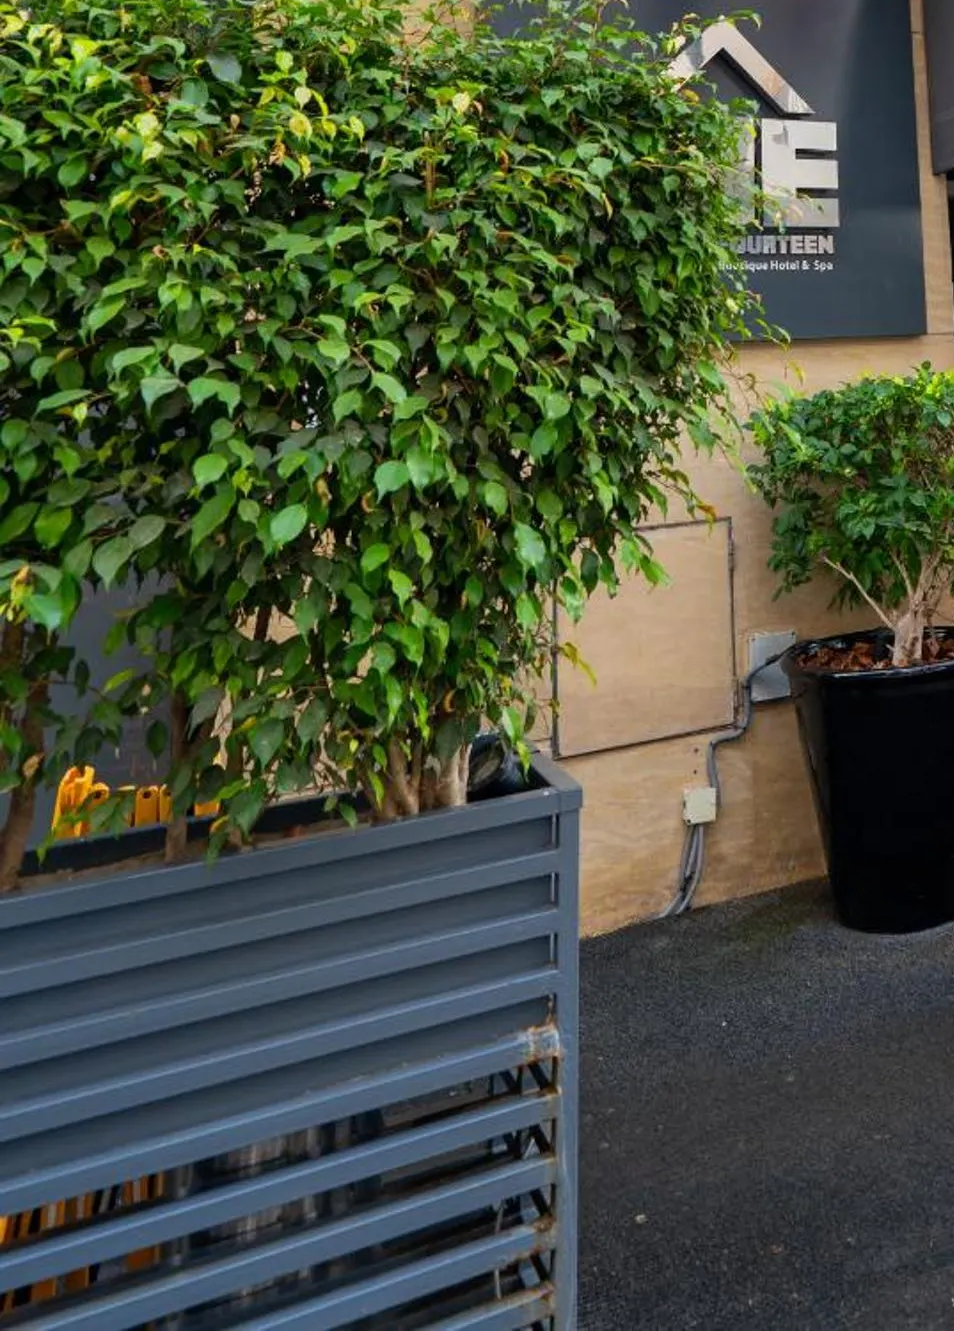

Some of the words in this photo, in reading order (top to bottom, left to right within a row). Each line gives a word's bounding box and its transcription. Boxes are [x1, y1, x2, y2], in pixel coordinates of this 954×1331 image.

[720, 235, 834, 255] OURTEEN
[770, 259, 800, 271] Hotel
[813, 259, 834, 273] Spa
